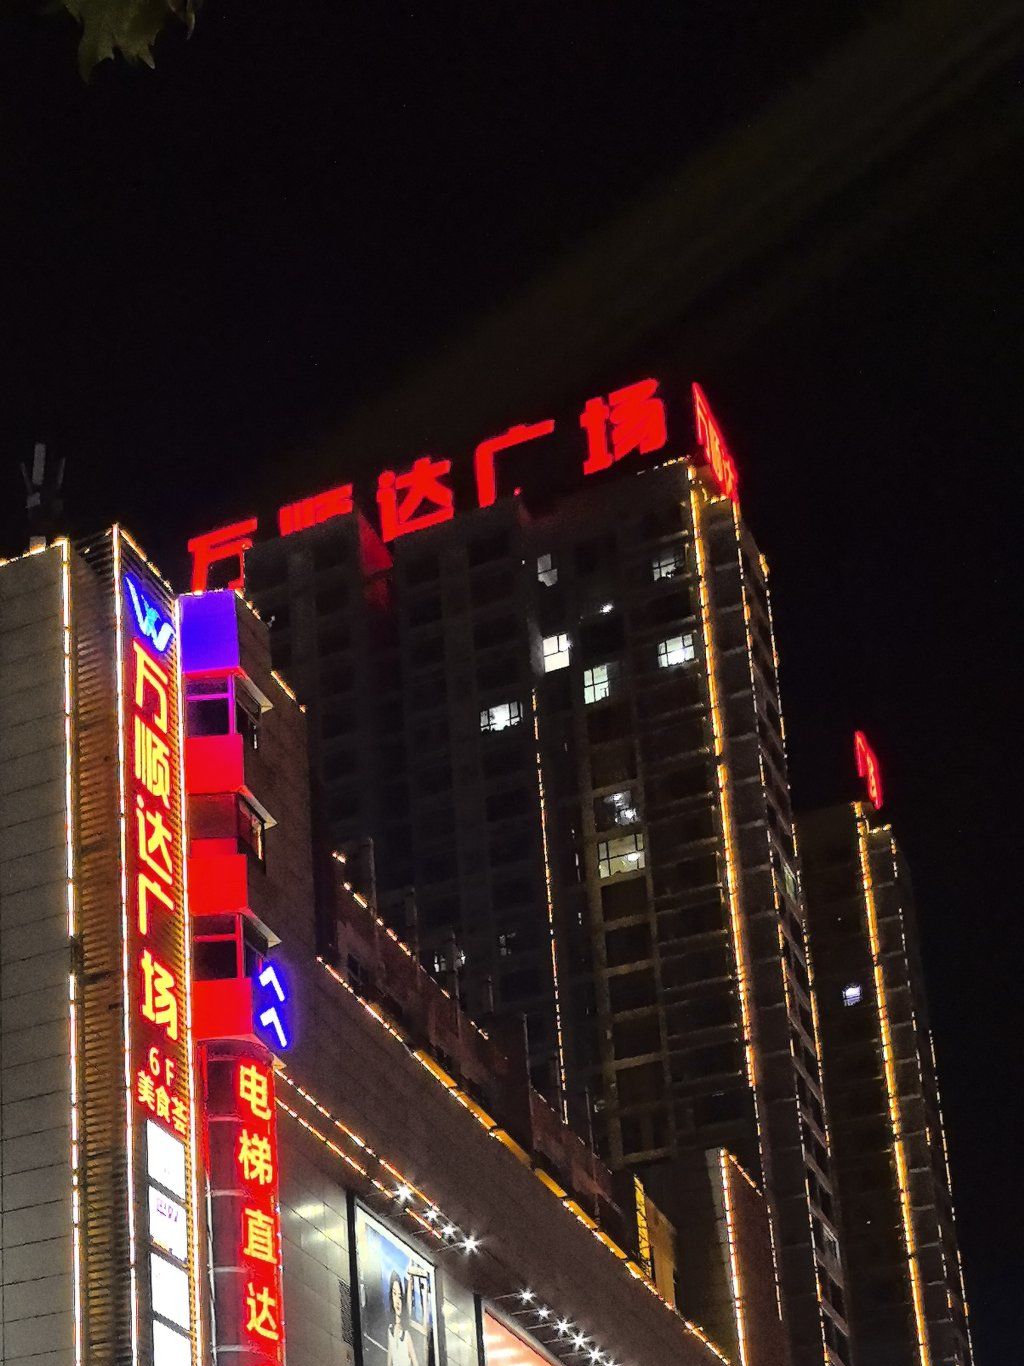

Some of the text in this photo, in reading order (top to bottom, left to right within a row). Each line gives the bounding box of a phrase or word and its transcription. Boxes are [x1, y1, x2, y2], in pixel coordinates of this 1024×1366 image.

[132, 638, 178, 1040] 万顺达广场
